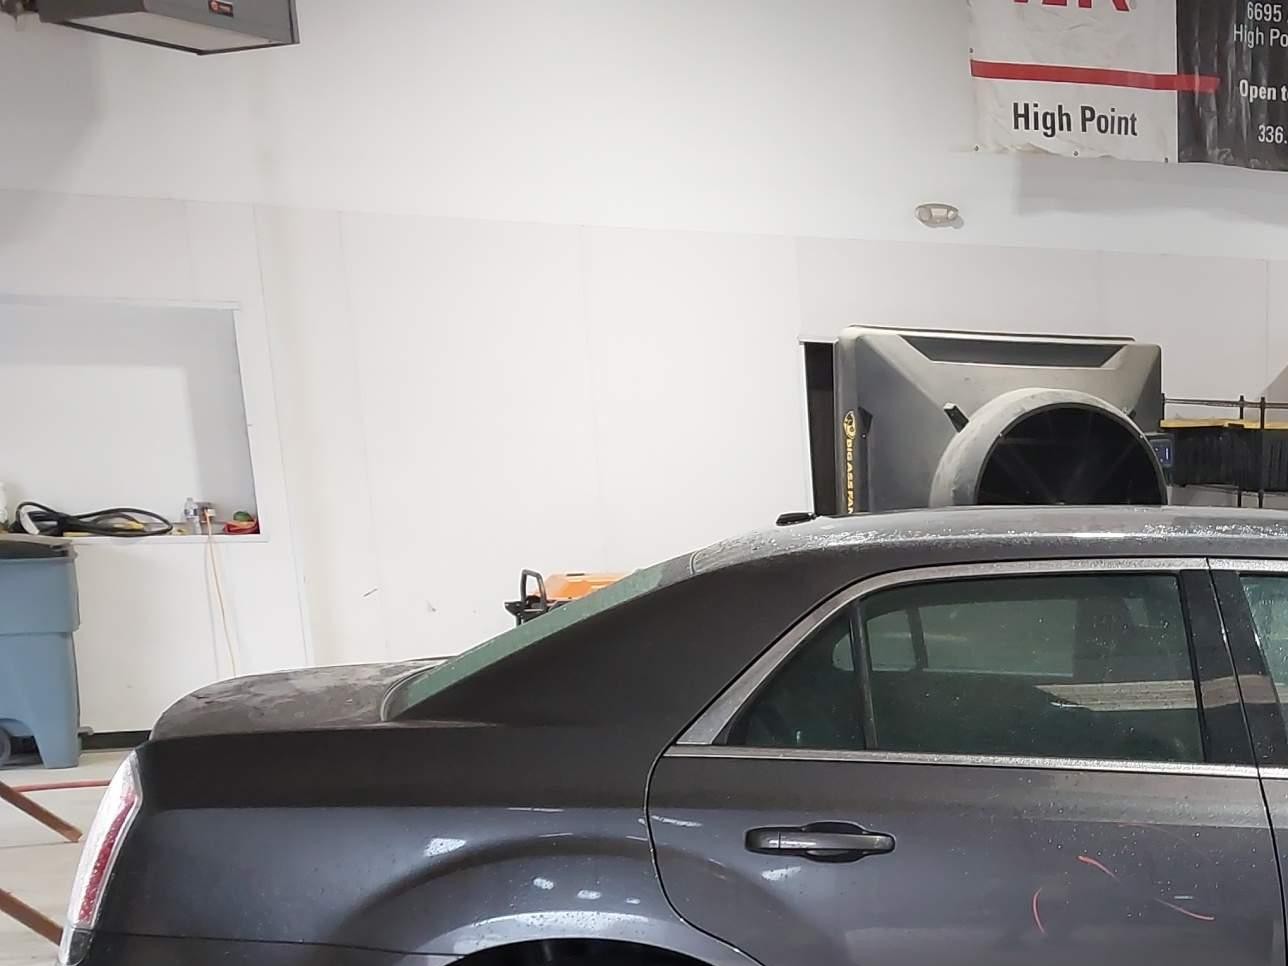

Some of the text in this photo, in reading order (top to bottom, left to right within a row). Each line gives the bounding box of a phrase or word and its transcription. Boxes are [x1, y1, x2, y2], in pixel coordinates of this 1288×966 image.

[1247, 1, 1282, 22] 6695
[1233, 24, 1264, 48] High
[1239, 79, 1277, 103] Open
[1013, 102, 1138, 138] High Point
